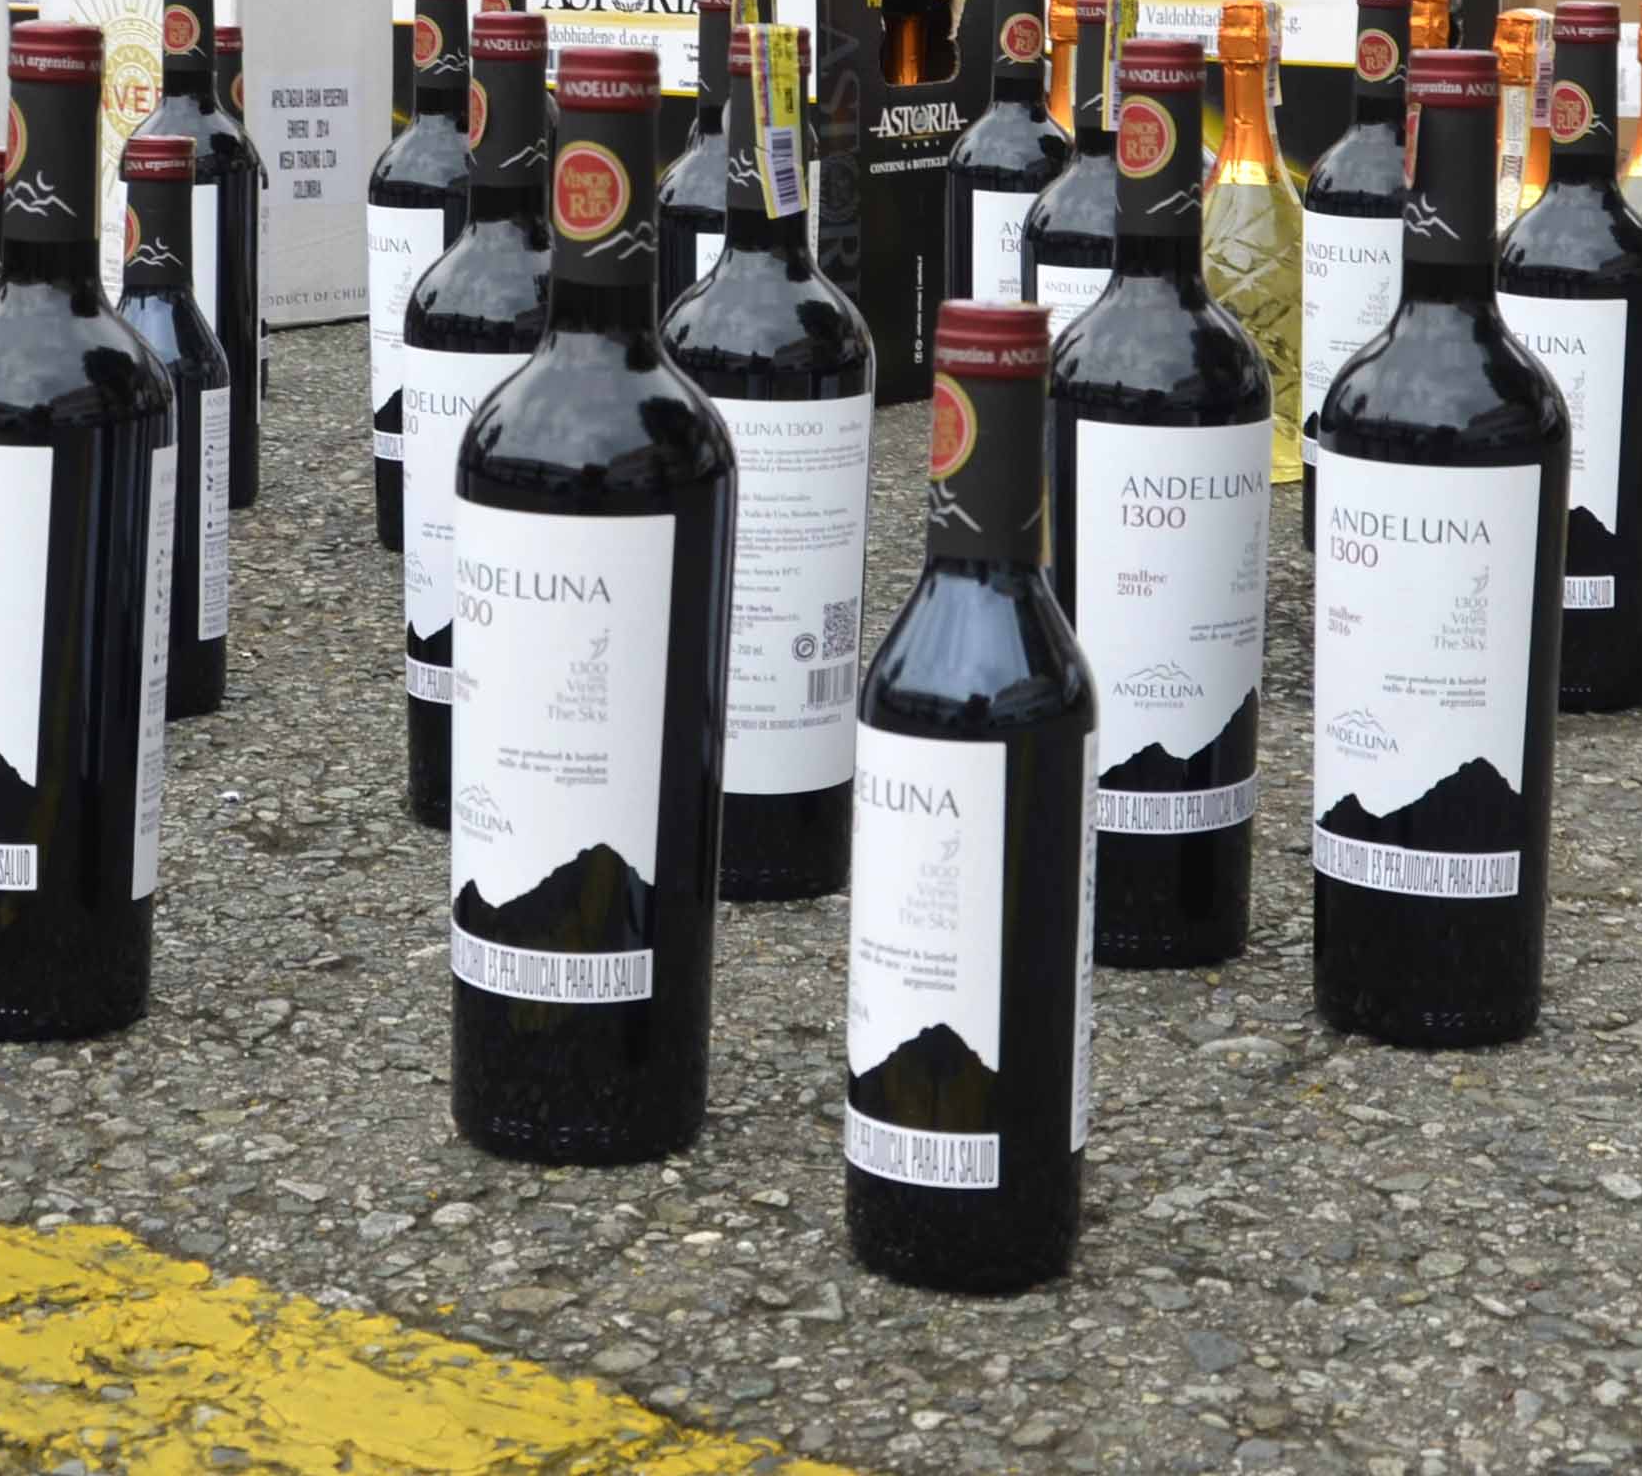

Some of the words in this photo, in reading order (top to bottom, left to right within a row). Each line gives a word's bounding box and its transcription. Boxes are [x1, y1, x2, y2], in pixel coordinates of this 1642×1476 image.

[27, 55, 85, 72] argentina
[565, 80, 645, 99] ANDELUNA
[869, 101, 968, 138] ASTORIA
[786, 422, 823, 437] 1300
[1121, 471, 1264, 502] ANDELUNA
[1121, 504, 1187, 529] 1300
[1331, 506, 1492, 545] ANDELUNA
[1329, 535, 1379, 568] 1300
[1117, 570, 1168, 585] malbec
[1117, 584, 1153, 597] 2016
[1432, 635, 1458, 649] The
[1113, 682, 1205, 698] ANDELUNA
[1132, 795, 1173, 831] ALCOHOL
[1174, 795, 1185, 830] ES
[1371, 849, 1383, 890] ES
[1384, 850, 1445, 895] PERJUDICIAL
[1447, 855, 1474, 895] PARA
[1475, 857, 1487, 895] LA
[1489, 856, 1516, 894] SALUD
[500, 950, 562, 999] PERJUDICIAL
[564, 956, 596, 999] PARA
[597, 957, 611, 999] LA
[613, 954, 647, 996] SALUD
[911, 1137, 941, 1181] PARA
[941, 1138, 956, 1183] LA
[958, 1138, 996, 1184] SALUD
